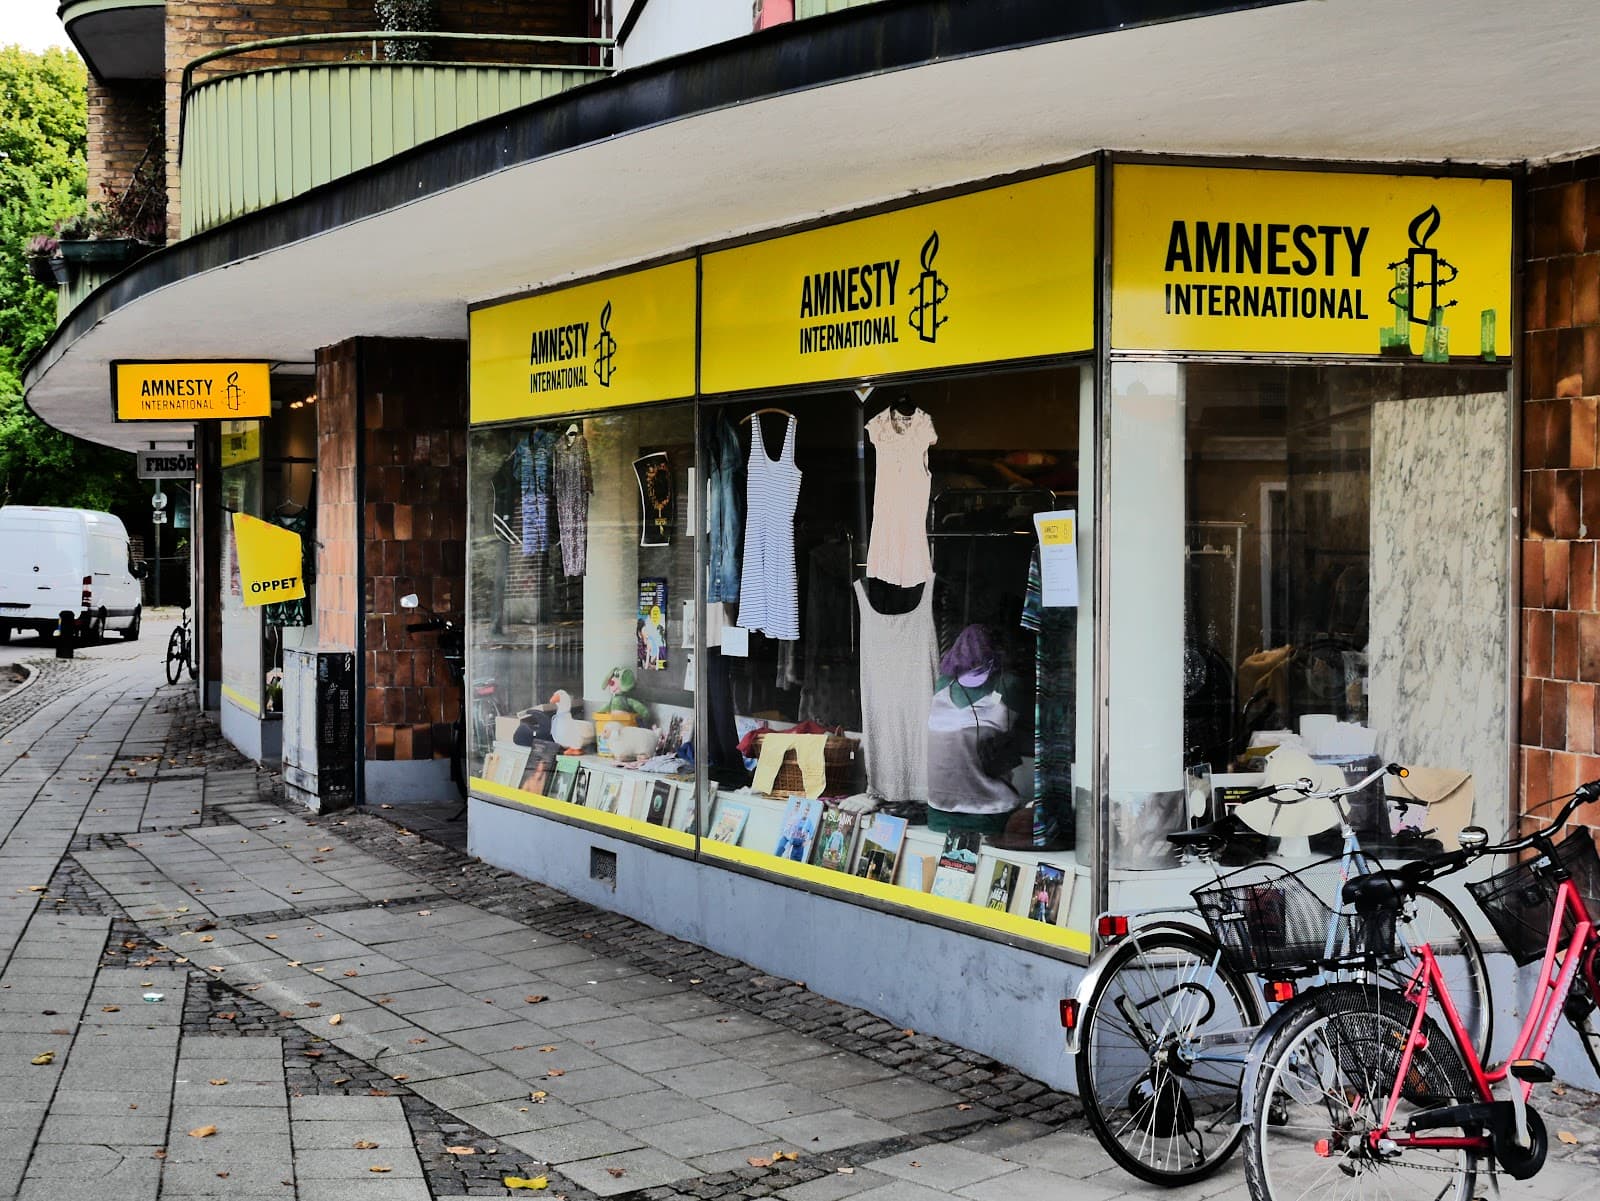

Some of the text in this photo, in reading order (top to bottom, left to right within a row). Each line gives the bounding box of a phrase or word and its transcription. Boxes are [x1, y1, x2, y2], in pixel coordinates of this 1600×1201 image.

[1165, 220, 1370, 277] AMNESTY
[800, 259, 900, 318] AMNESTY
[1165, 284, 1369, 320] INTERNATIONAL
[530, 321, 589, 366] AMNESTY
[799, 315, 899, 354] INTERNATIONAL
[141, 379, 213, 396] AMNESTY
[530, 366, 588, 393] INTERNATIONAL
[141, 400, 214, 411] INTERNATIONAL
[146, 455, 195, 472] FRISÖR
[251, 577, 298, 593] ÖPPET
